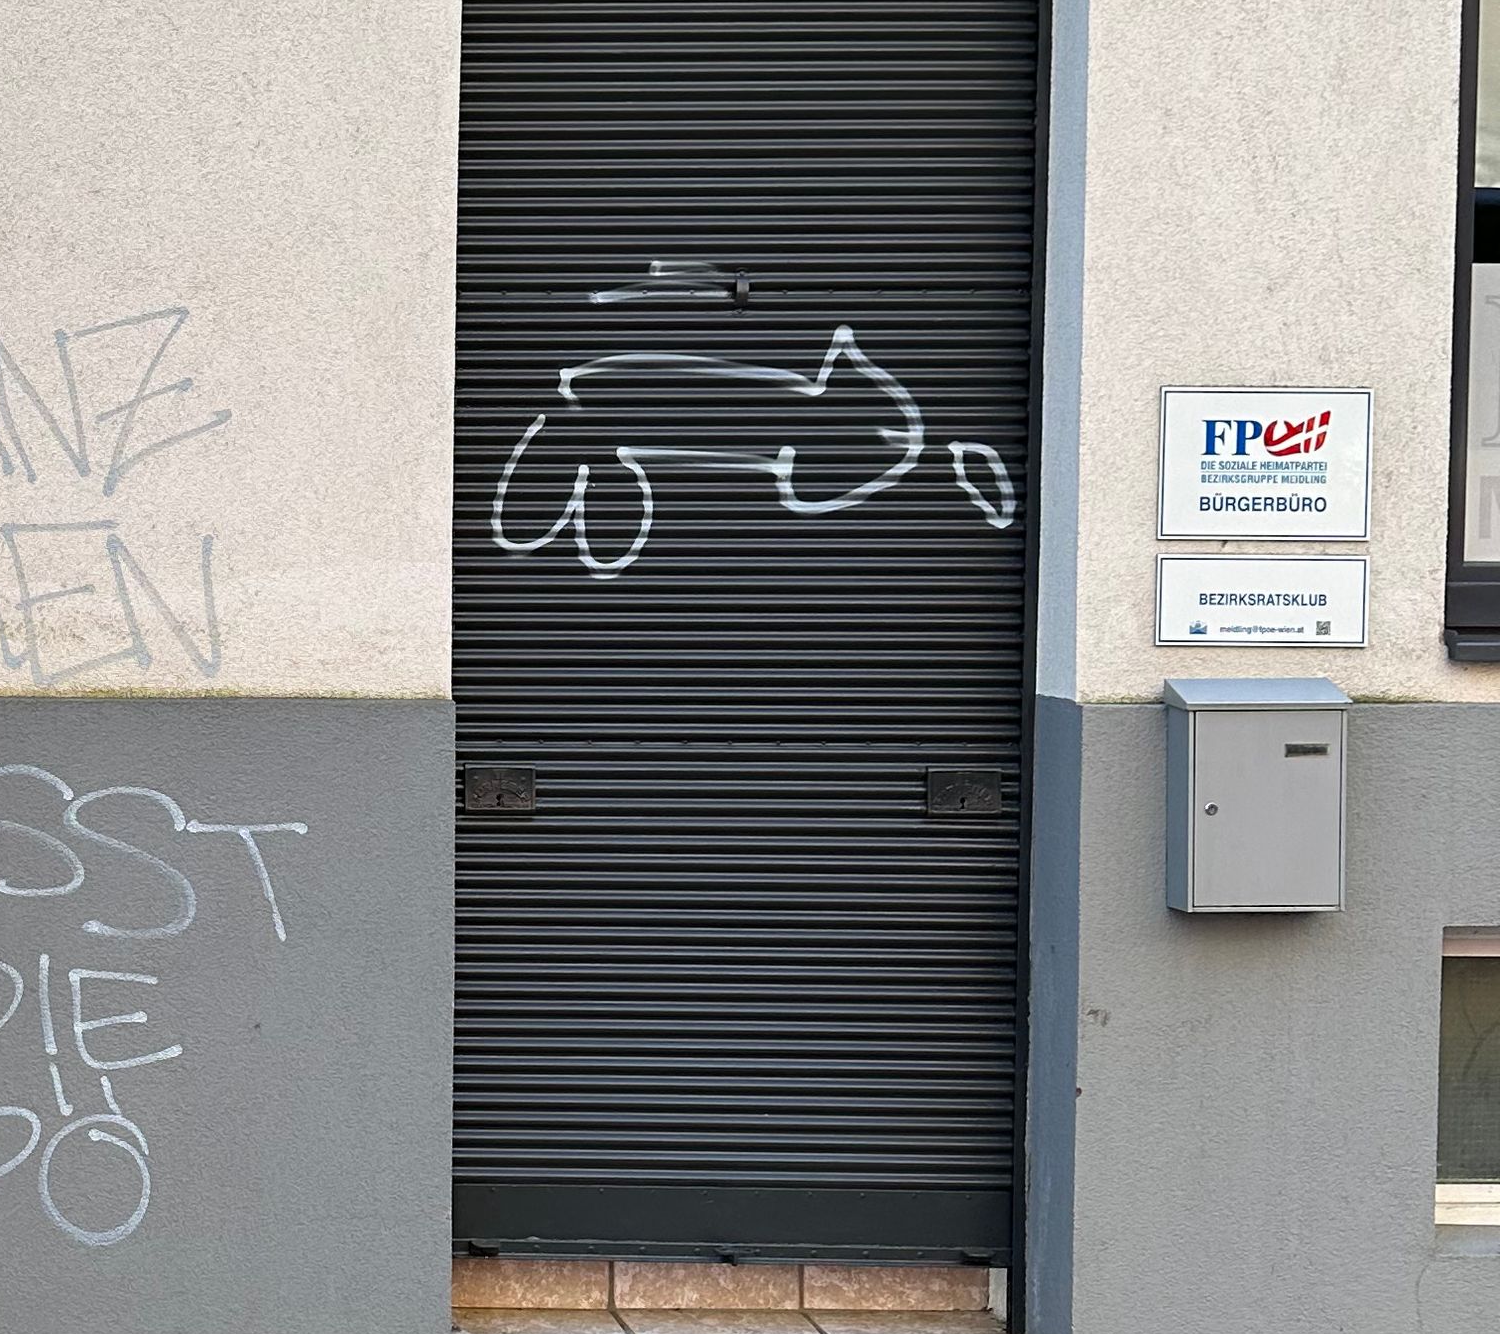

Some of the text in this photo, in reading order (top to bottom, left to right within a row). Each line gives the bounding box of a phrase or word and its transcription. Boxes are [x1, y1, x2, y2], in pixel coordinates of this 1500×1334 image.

[1201, 460, 1328, 472] DIE SOZIALE HEIMATPARTEI
[1200, 474, 1327, 484] BEZIRKSGRUPPE MEIDLING
[1199, 492, 1328, 513] BÜRGERBÜRO
[1198, 593, 1328, 607] BEZIRKSRATSKLUB
